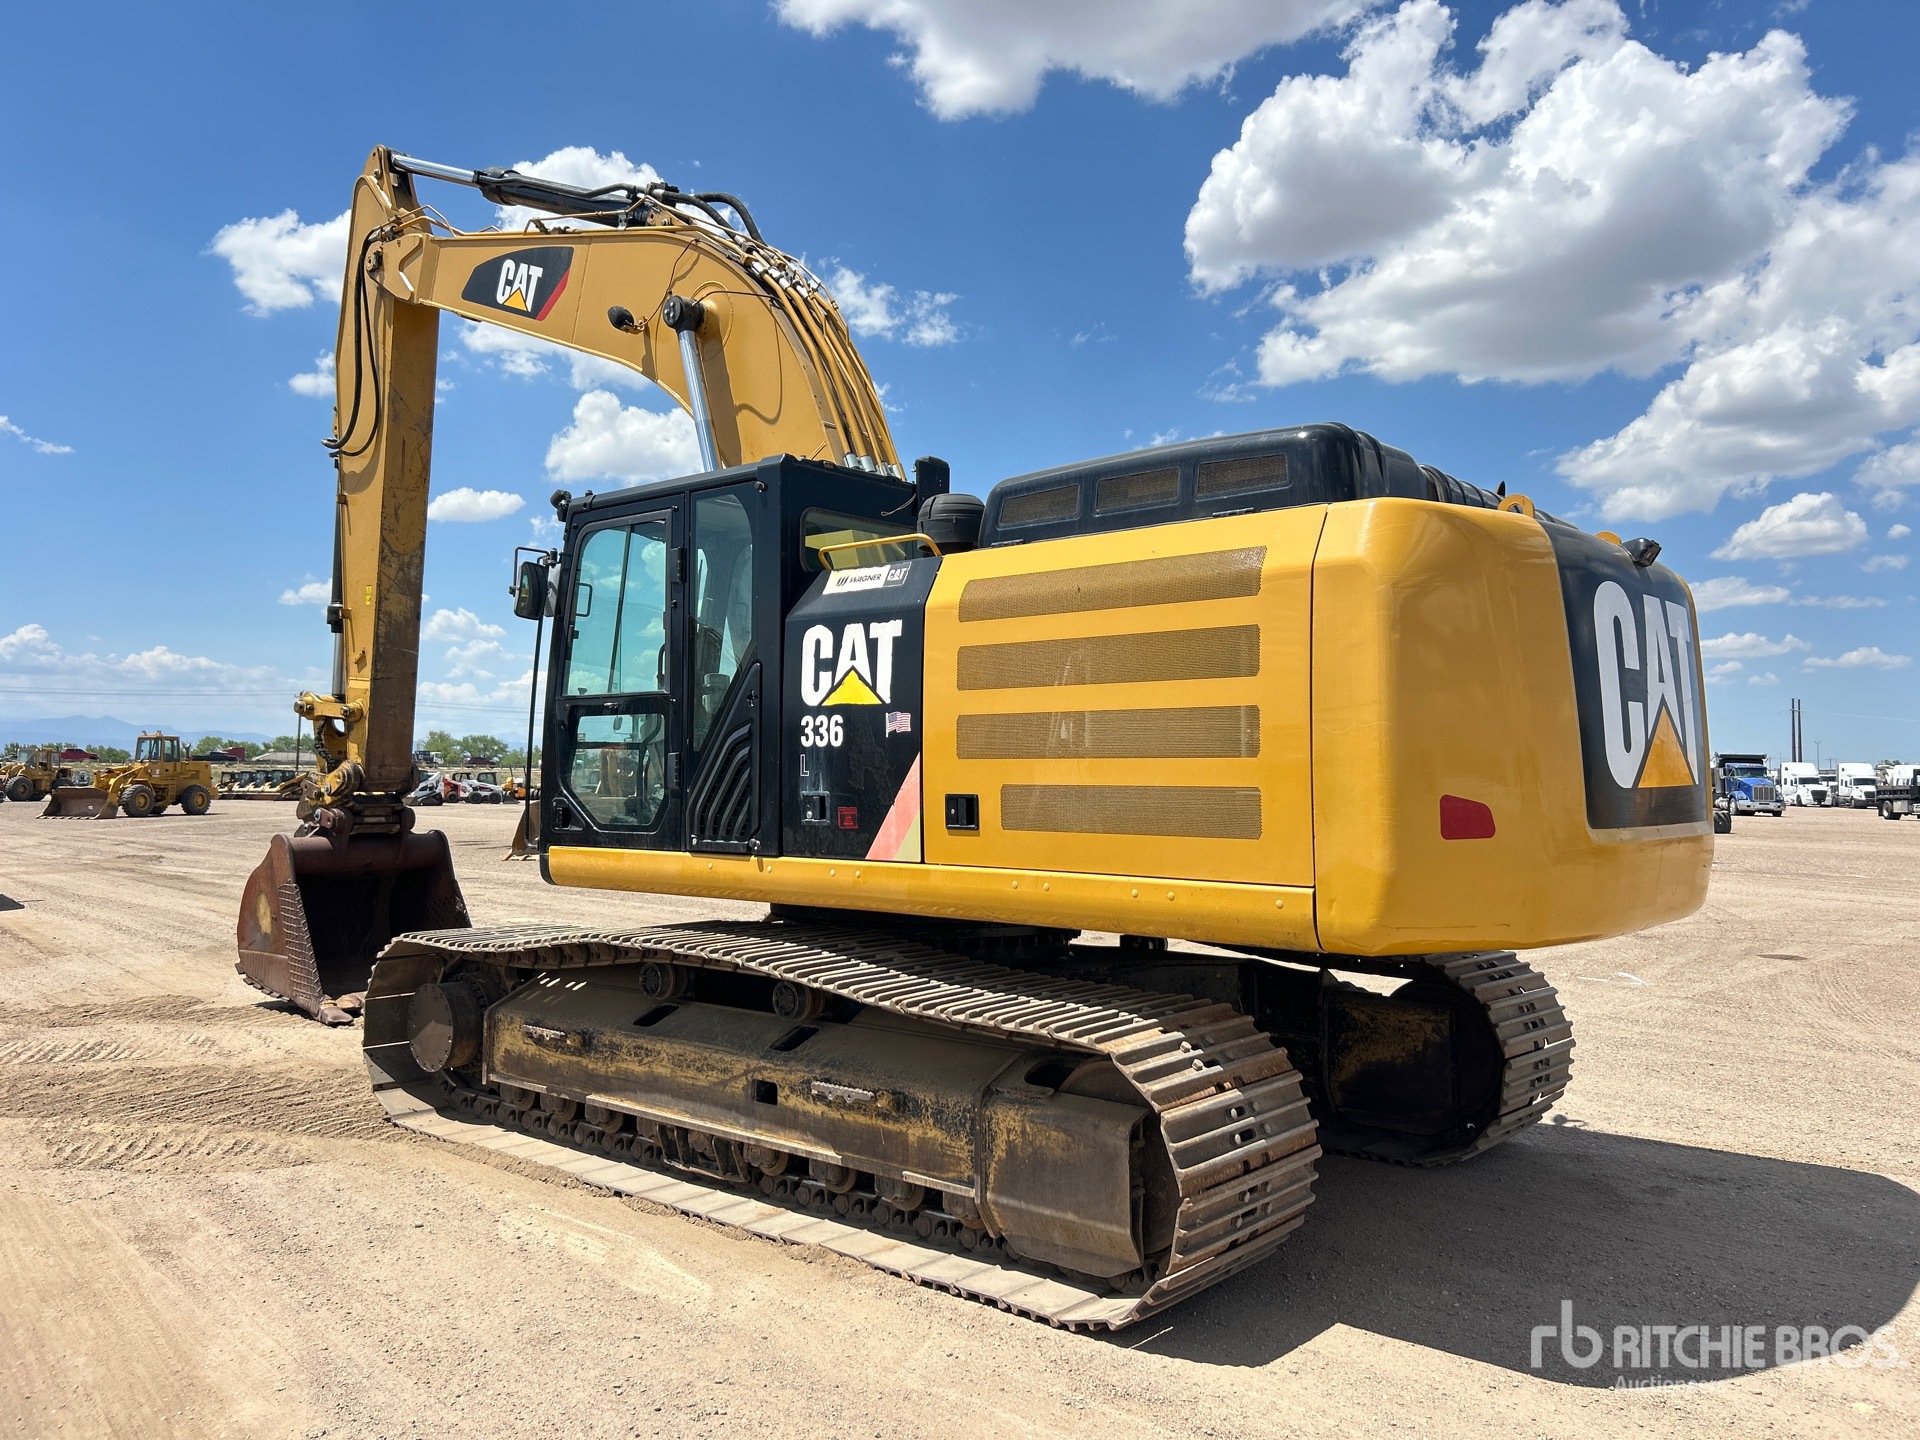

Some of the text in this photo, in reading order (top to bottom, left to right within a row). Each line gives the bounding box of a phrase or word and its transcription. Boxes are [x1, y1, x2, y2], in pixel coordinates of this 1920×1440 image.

[496, 258, 544, 313] CAT
[849, 567, 909, 584] WAGNER CAT
[800, 618, 903, 707] CAT
[1593, 580, 1699, 789] CAT
[800, 714, 844, 748] 336
[799, 753, 810, 777] L
